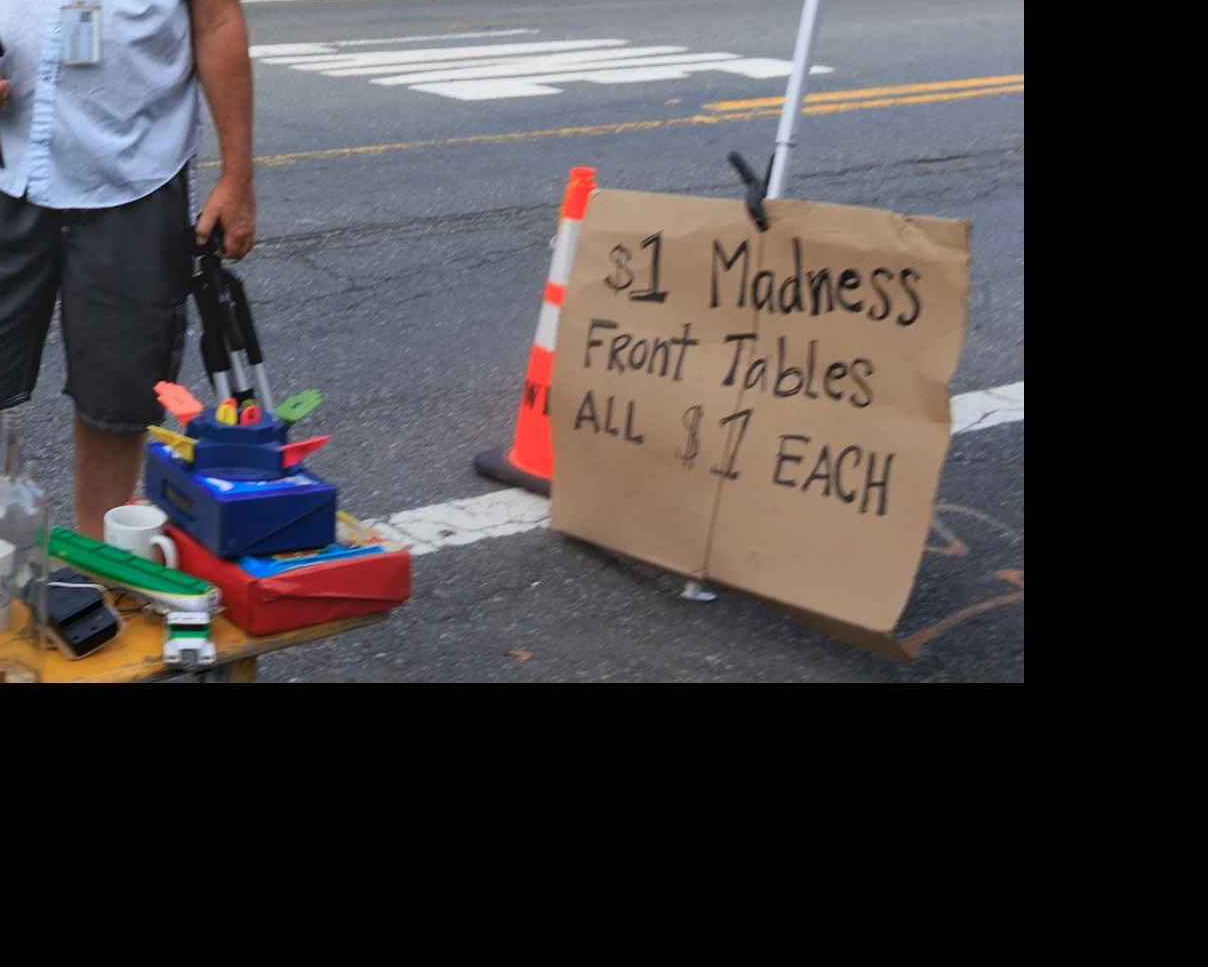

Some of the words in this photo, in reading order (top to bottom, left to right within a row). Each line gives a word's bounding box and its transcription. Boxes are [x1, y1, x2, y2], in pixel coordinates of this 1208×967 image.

[603, 230, 669, 305] $1
[708, 237, 923, 327] Madness
[721, 333, 875, 409] Tables
[573, 389, 645, 445] ALL
[675, 404, 753, 481] $1
[771, 434, 895, 517] EACH
